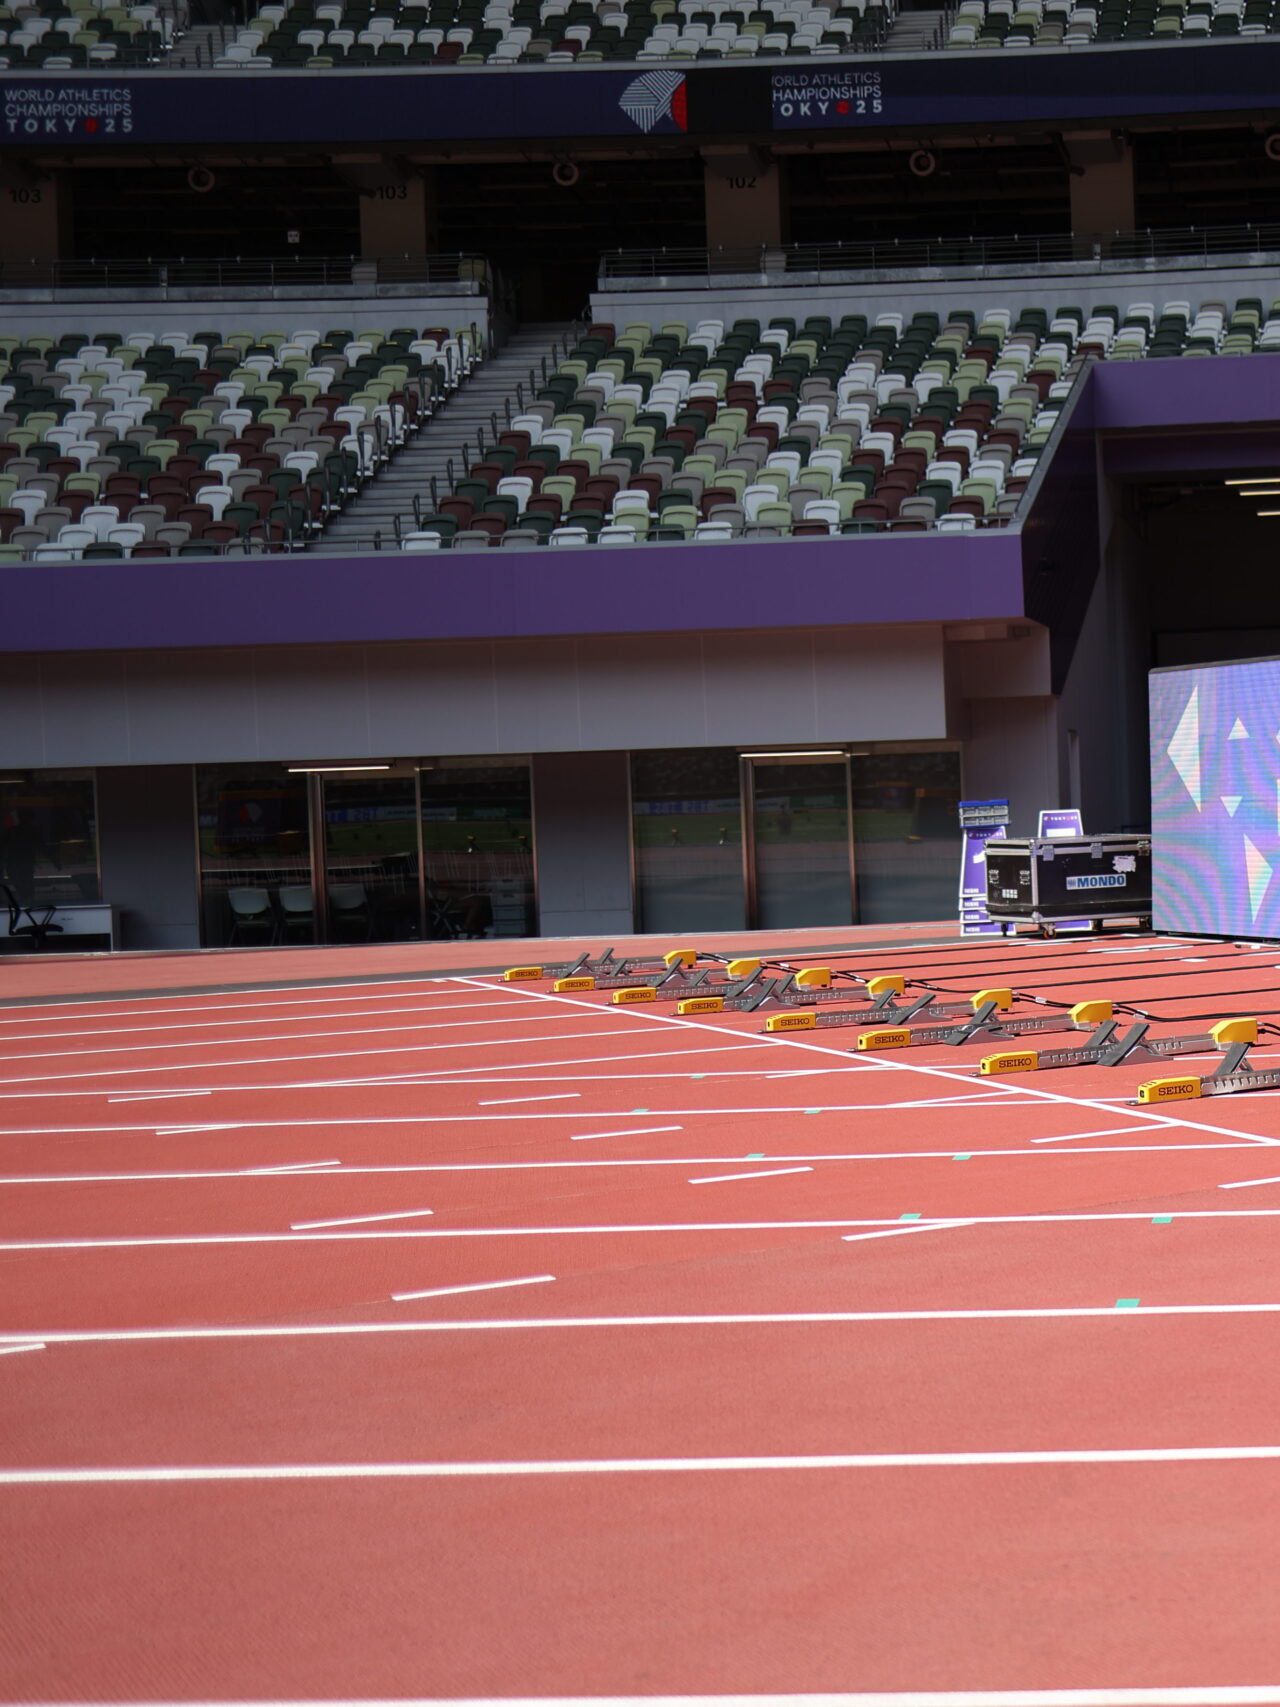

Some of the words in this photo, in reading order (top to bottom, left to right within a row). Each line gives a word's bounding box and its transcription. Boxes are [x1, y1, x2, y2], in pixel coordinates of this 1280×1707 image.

[771, 75, 809, 87] ORLD
[812, 72, 881, 85] ATHLETICS
[5, 89, 55, 101] WORLD
[58, 89, 131, 101] ATHLETICS
[772, 85, 882, 101] HAMPIONSHIPS
[5, 103, 132, 116] CHAMPIONSHIPS
[9, 188, 41, 203] 103
[376, 186, 408, 200] 103
[1077, 875, 1125, 888] MONDO
[625, 991, 651, 1000] SEIKO
[691, 1001, 718, 1010] SEIKO
[780, 1017, 810, 1027] SEIKO
[874, 1034, 905, 1044] SEIKO
[998, 1057, 1032, 1068] SEIKO
[1158, 1084, 1194, 1096] SEIKO
